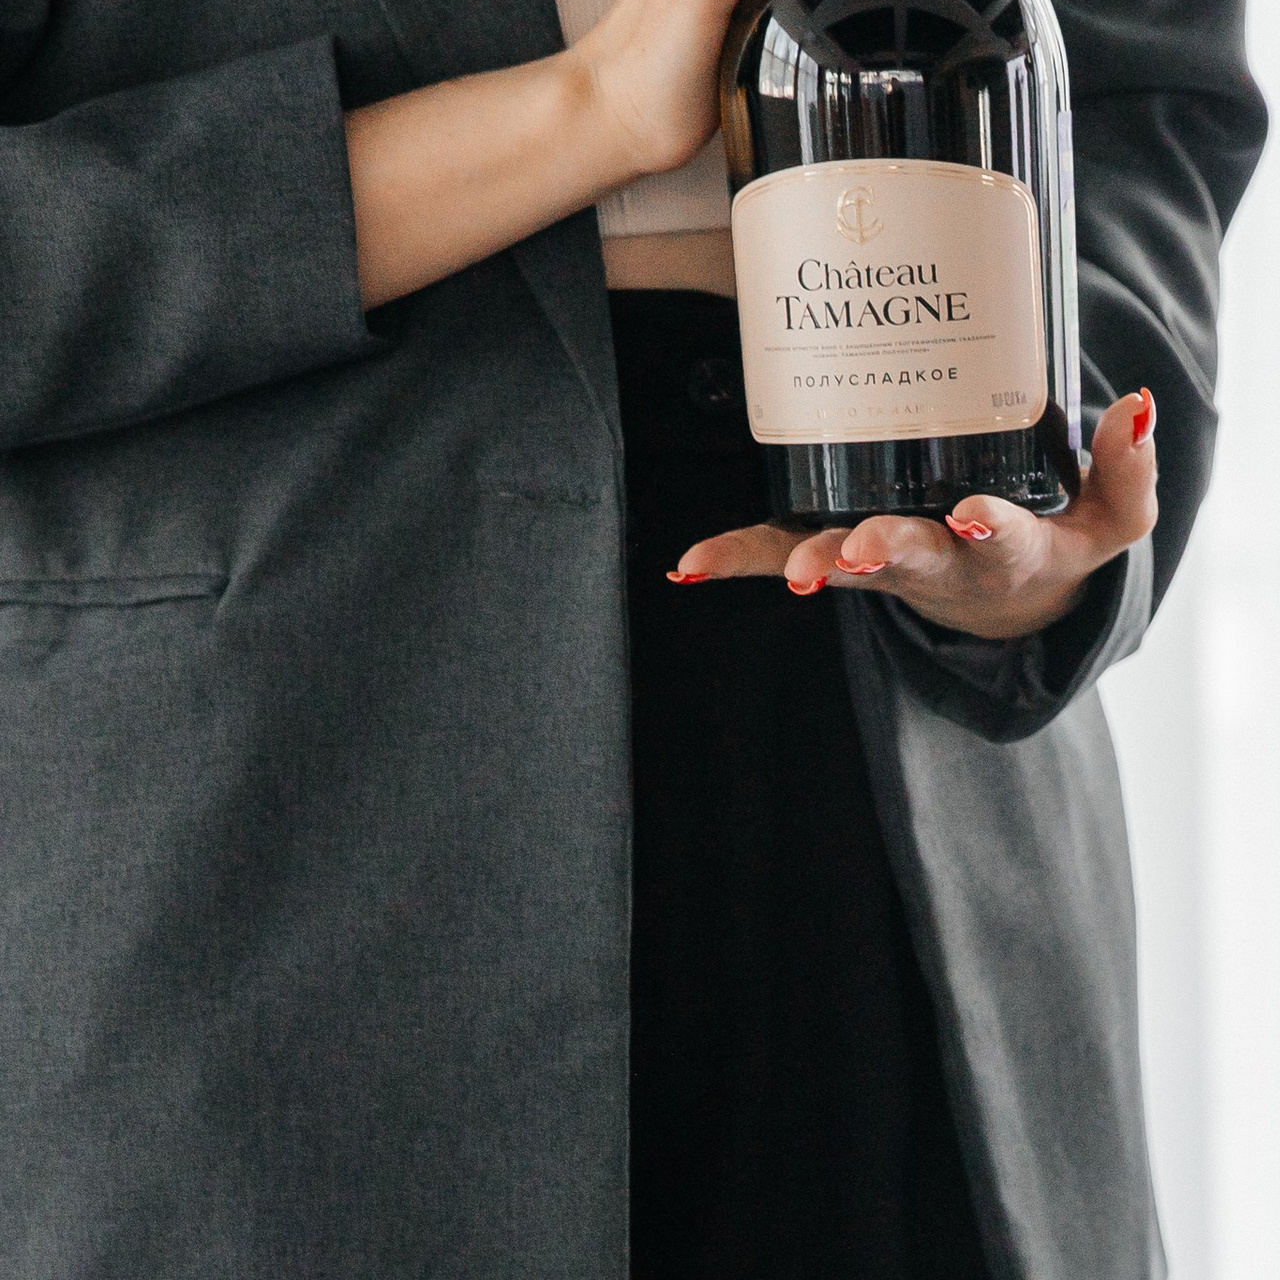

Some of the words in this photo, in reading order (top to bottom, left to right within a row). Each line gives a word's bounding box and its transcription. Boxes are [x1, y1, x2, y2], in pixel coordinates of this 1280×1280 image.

[797, 258, 939, 292] Château
[776, 292, 971, 331] TAMAGNE
[793, 367, 958, 388] ПОЛУСЛАДКОЕ
